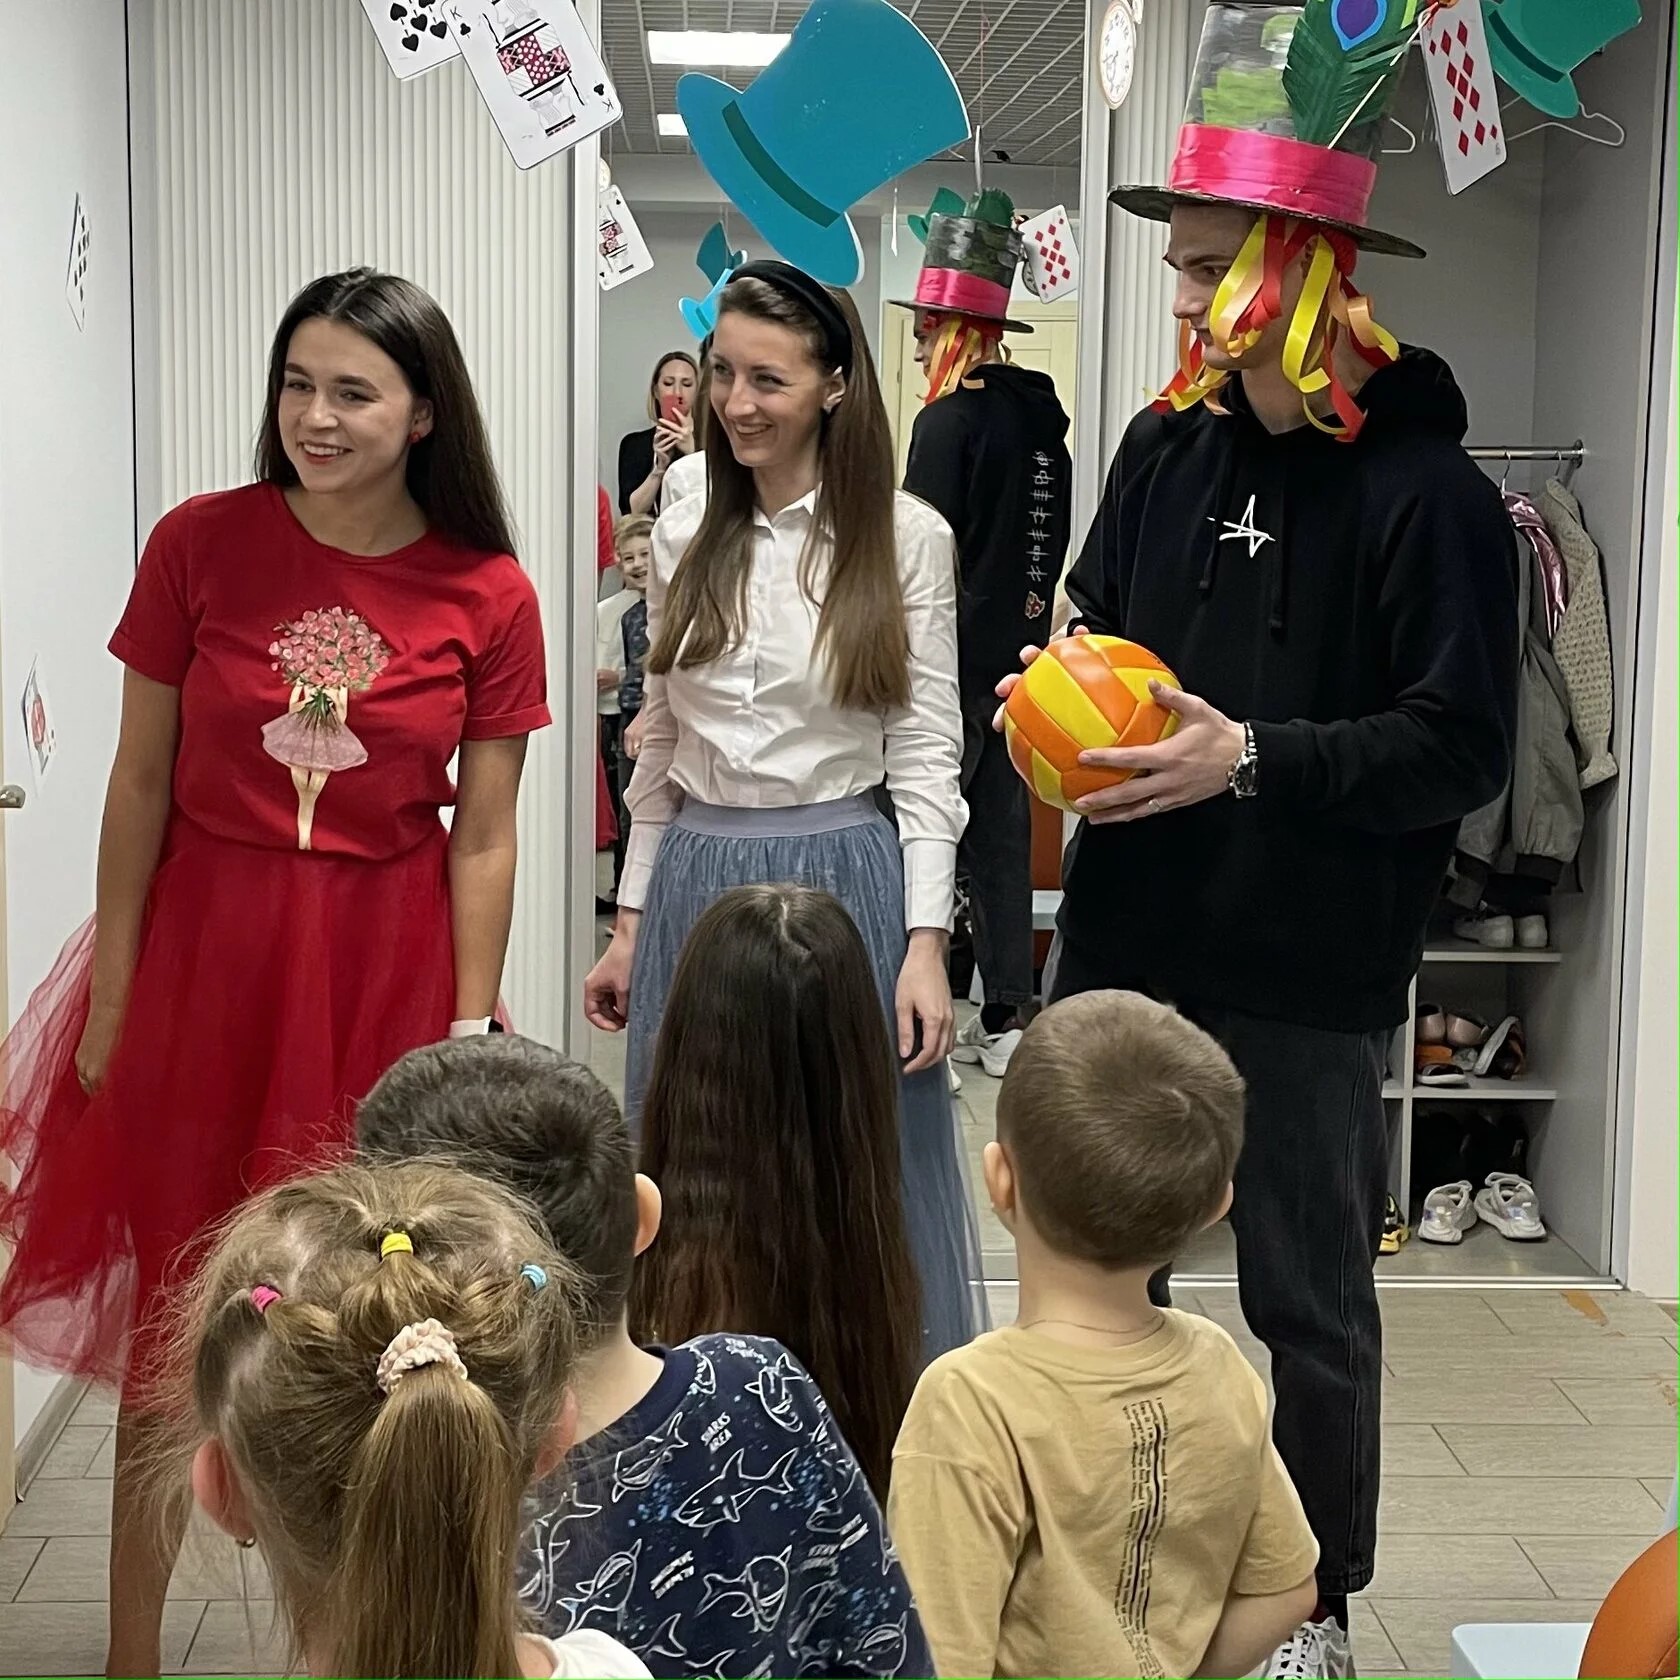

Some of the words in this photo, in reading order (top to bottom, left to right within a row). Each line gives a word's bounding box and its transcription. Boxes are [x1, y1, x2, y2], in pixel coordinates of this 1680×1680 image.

[450, 5, 462, 20] K
[601, 97, 614, 113] K
[701, 1411, 731, 1446] SHARKS
